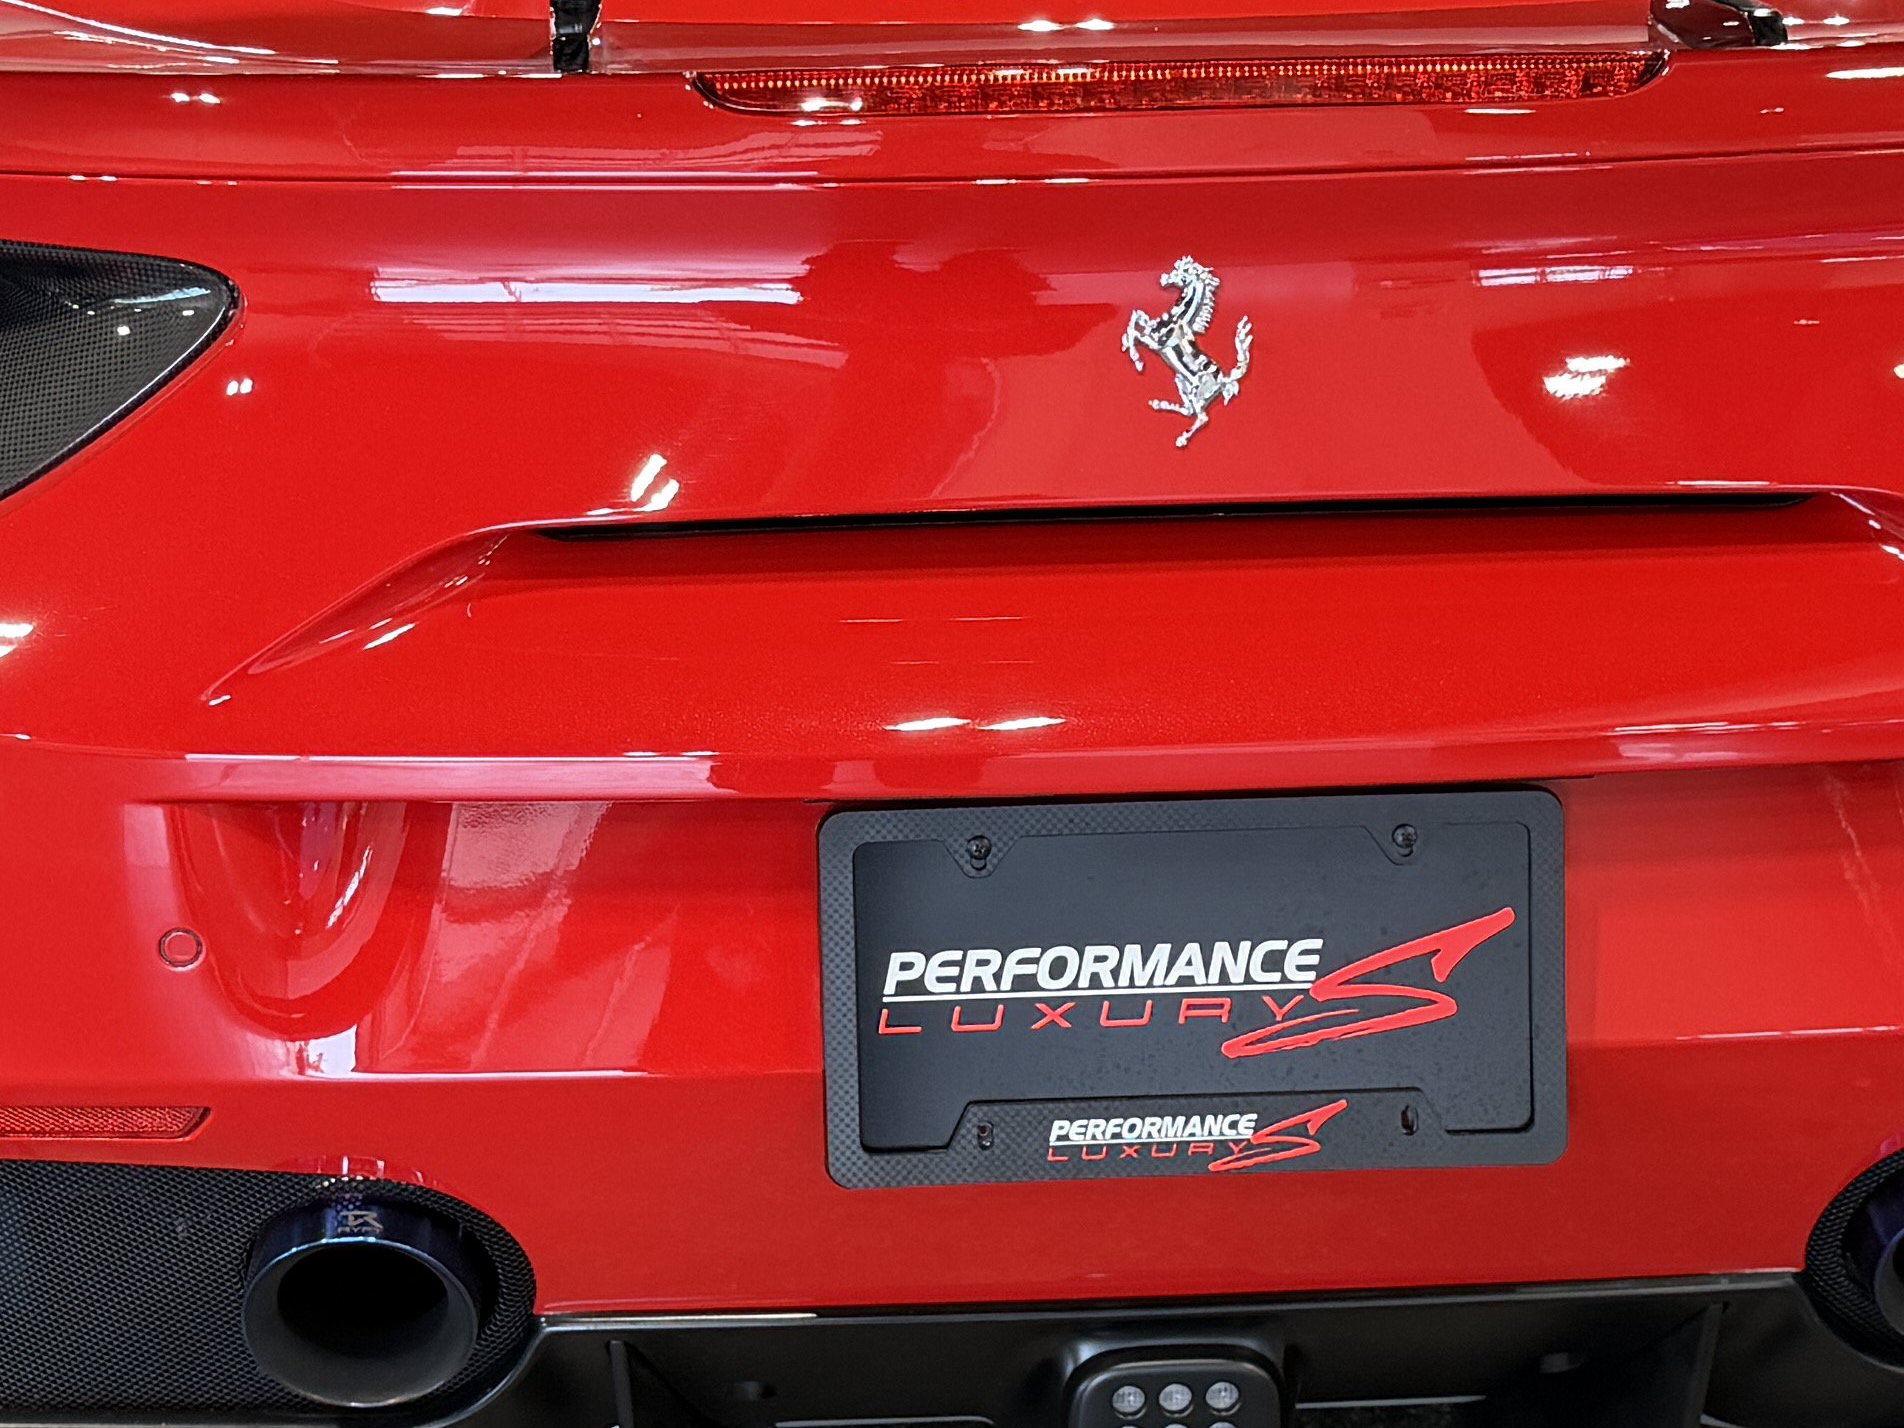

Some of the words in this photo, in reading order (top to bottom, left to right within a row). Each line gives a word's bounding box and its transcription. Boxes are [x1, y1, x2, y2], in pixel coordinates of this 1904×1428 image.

[883, 938, 1324, 995] PERFORMANCE
[878, 994, 1305, 1035] LUXURY
[1049, 1113, 1258, 1142] PERFORMANCE
[1047, 1141, 1248, 1161] LUXURY
